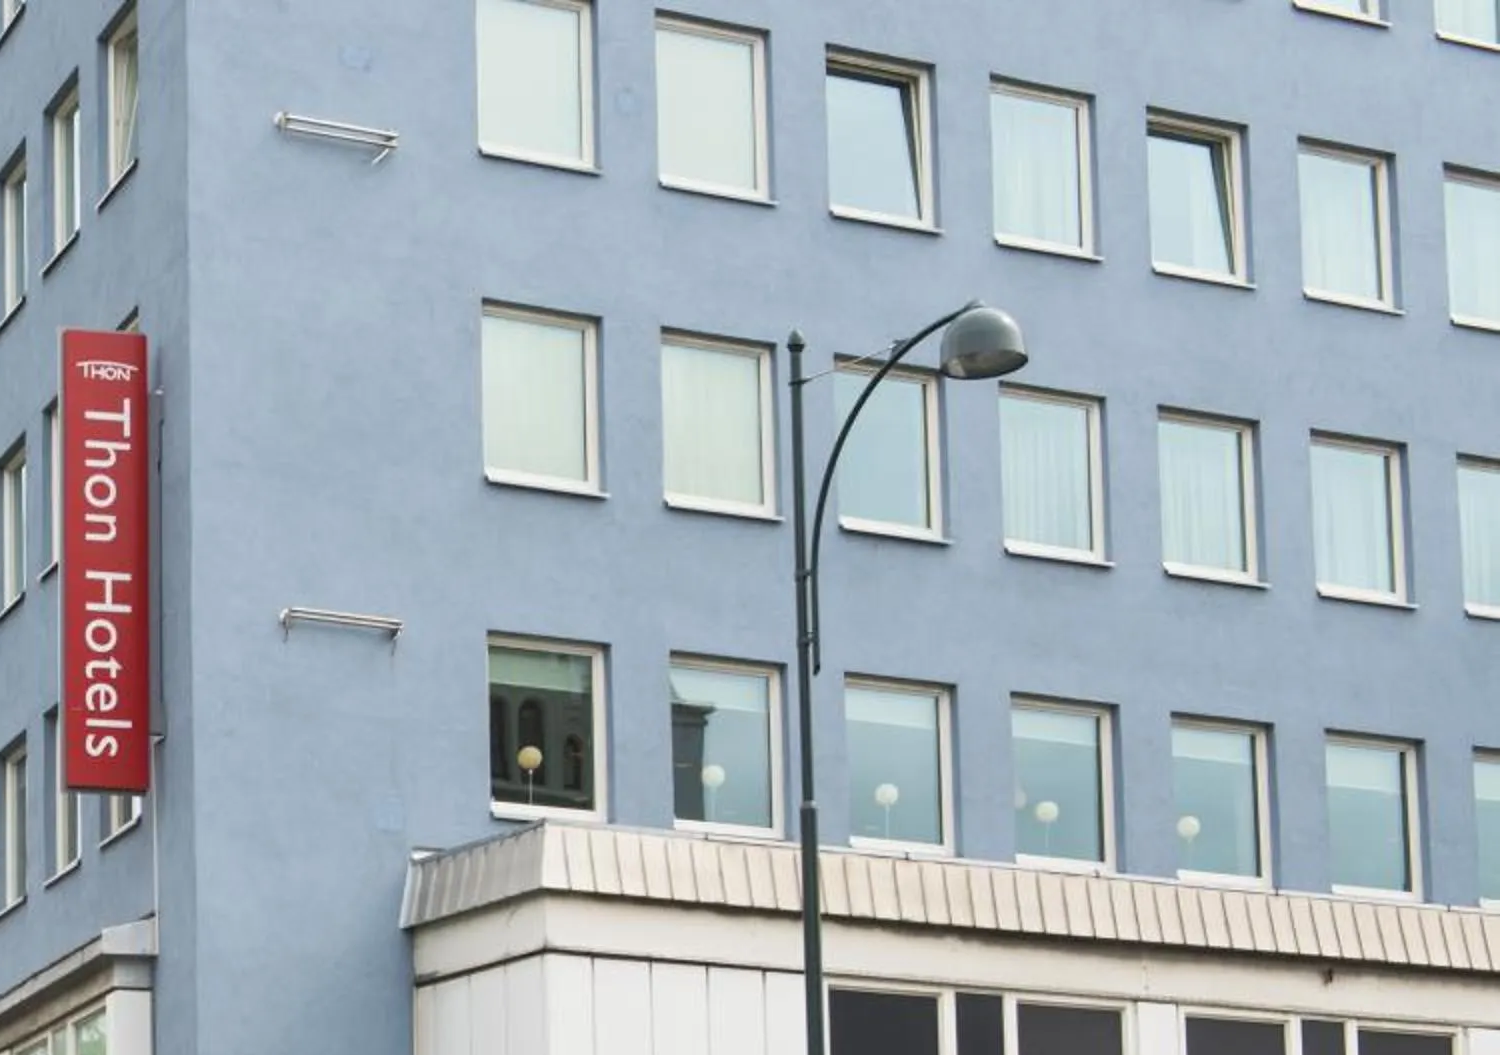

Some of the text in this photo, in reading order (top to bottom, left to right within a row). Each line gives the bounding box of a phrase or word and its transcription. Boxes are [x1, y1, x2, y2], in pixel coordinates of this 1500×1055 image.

[75, 360, 139, 382] THON
[84, 397, 132, 759] Thon Hotels
